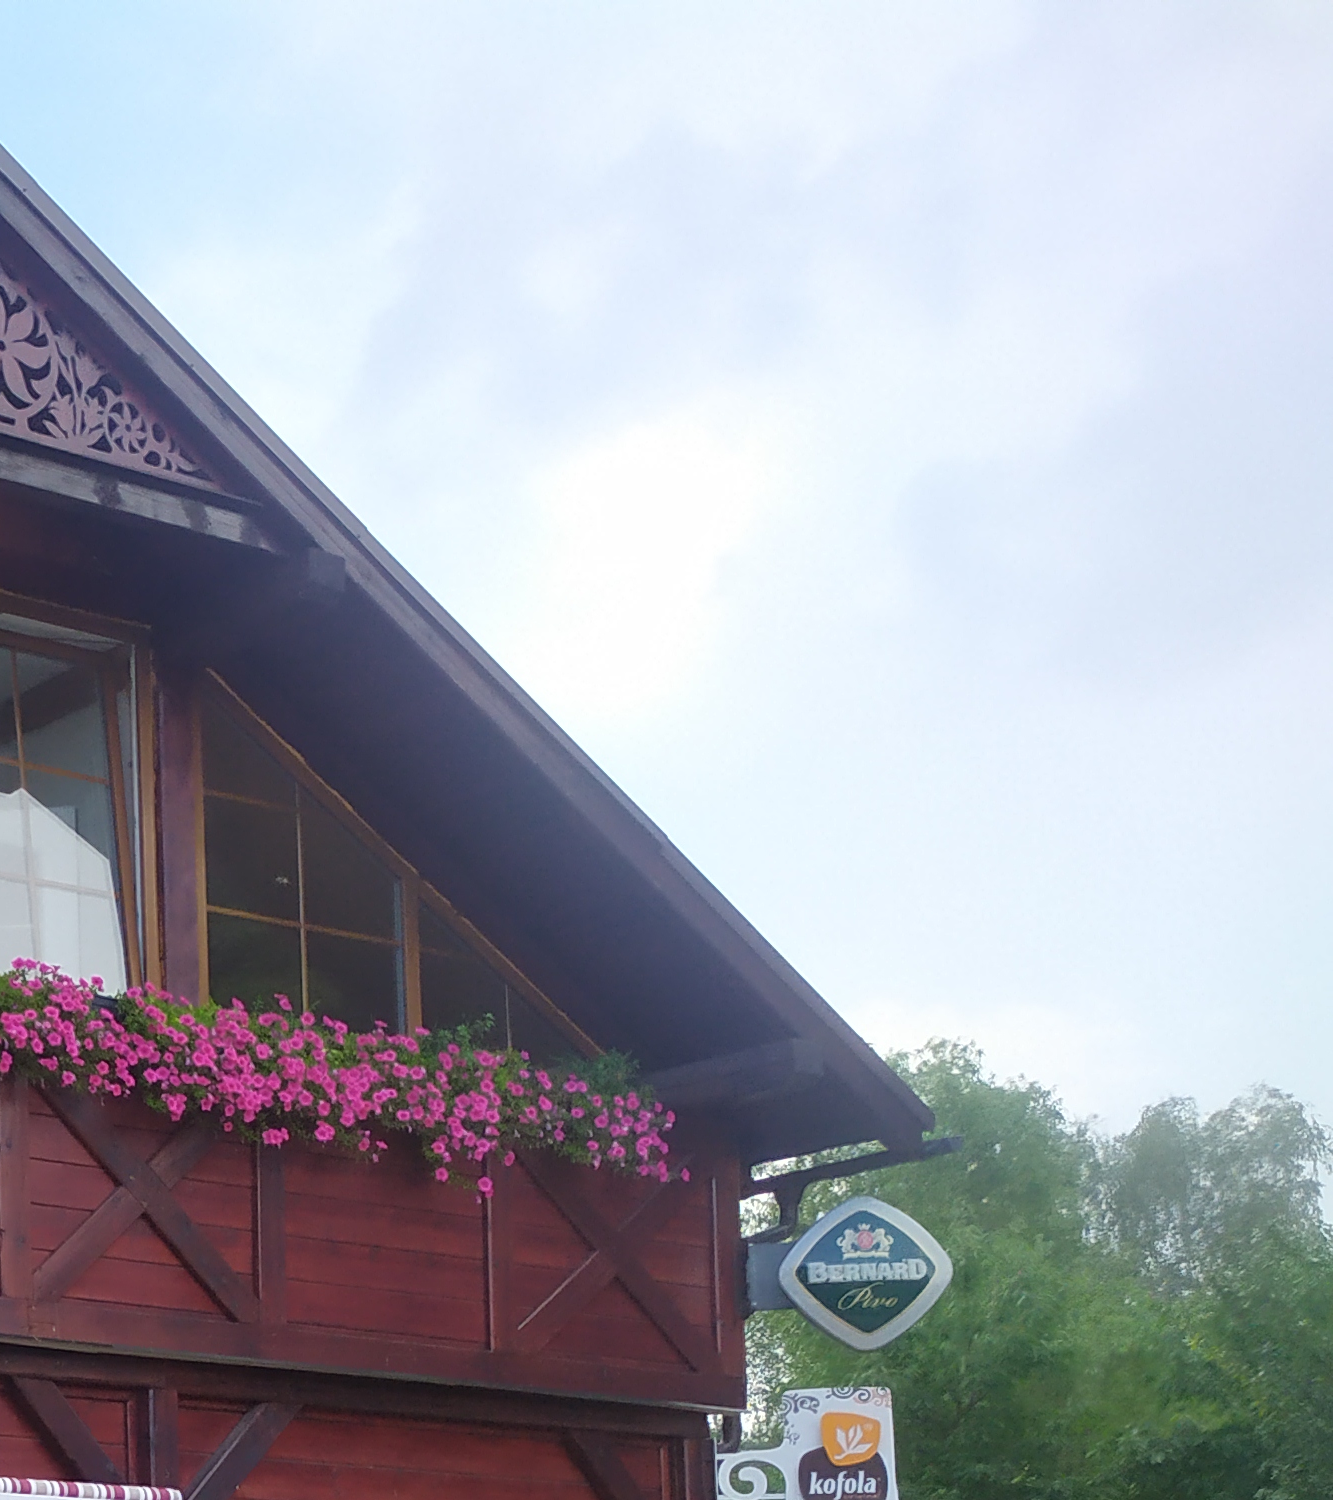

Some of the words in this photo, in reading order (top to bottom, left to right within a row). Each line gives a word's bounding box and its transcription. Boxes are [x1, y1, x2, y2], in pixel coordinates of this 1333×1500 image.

[807, 1259, 928, 1285] BERNARD
[838, 1282, 899, 1311] Pivo
[809, 1471, 877, 1500] kofola
